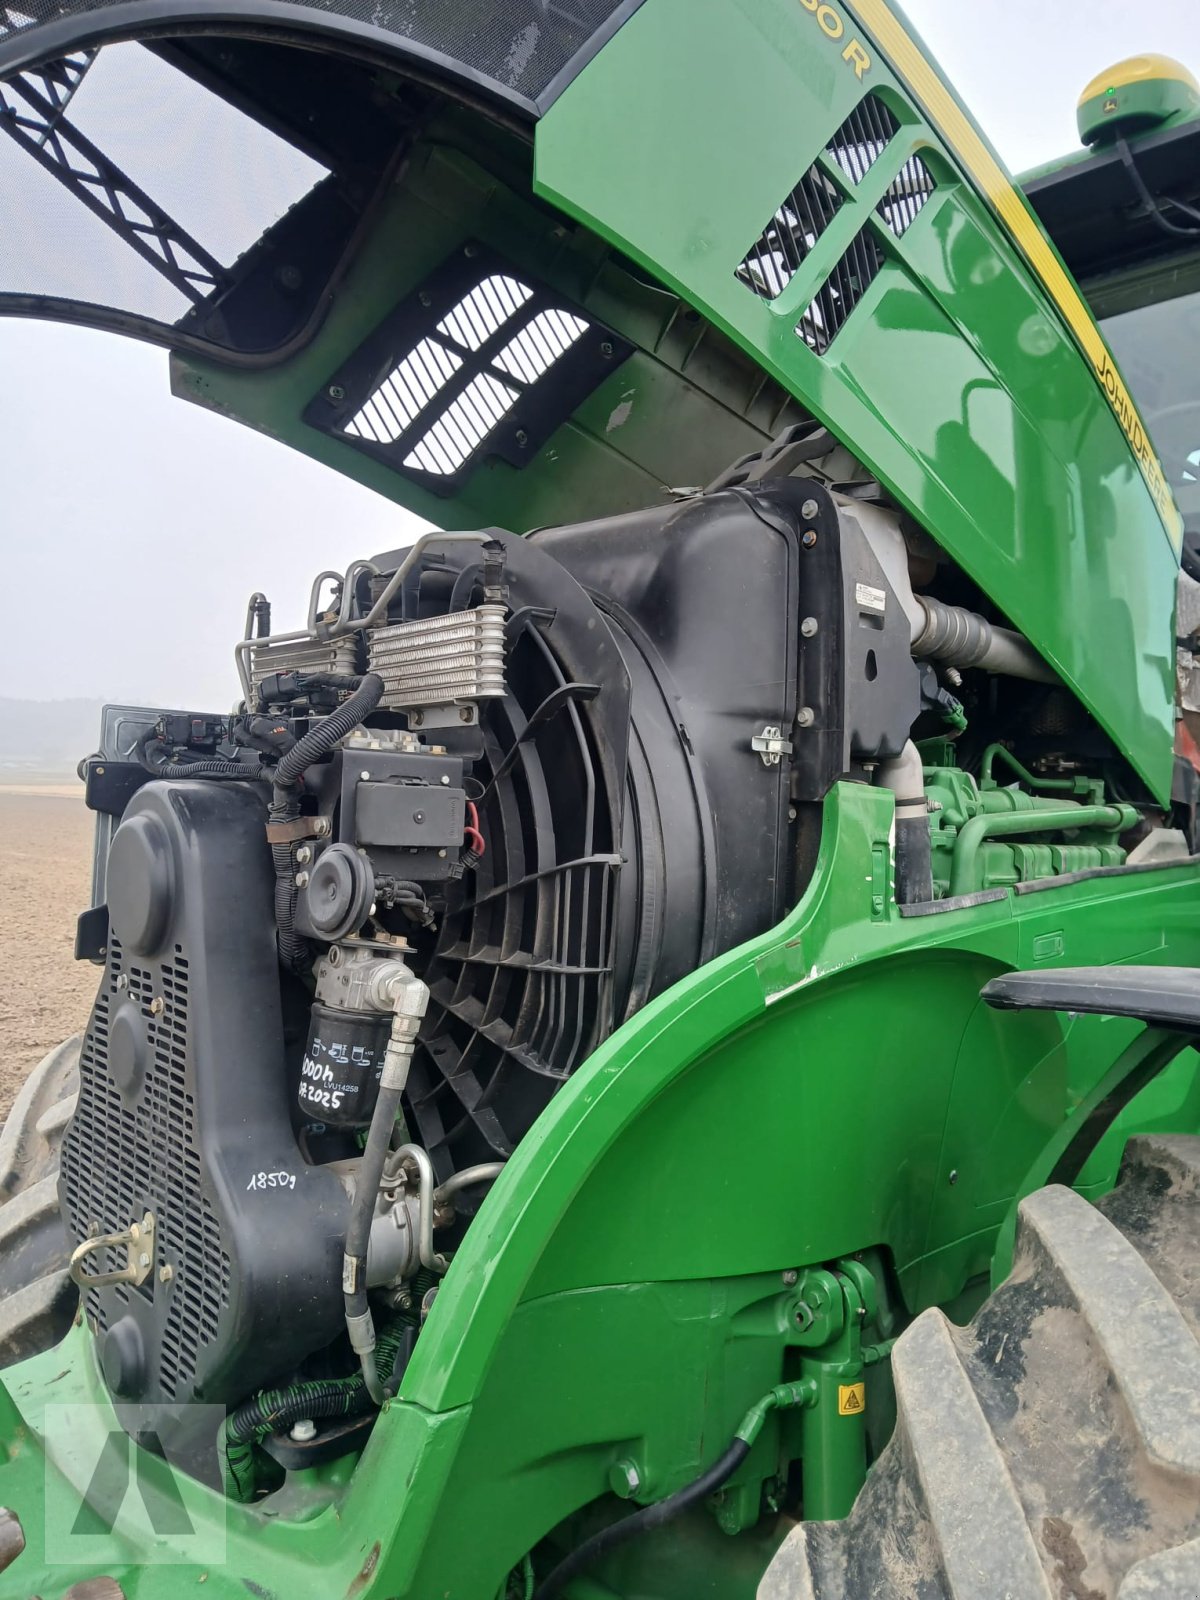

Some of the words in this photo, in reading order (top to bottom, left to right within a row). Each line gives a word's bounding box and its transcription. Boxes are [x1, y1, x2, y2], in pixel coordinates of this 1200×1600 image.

[800, 0, 844, 38] 0
[841, 38, 871, 80] R
[1097, 354, 1133, 434] JOHN
[1132, 421, 1168, 514] DEERE
